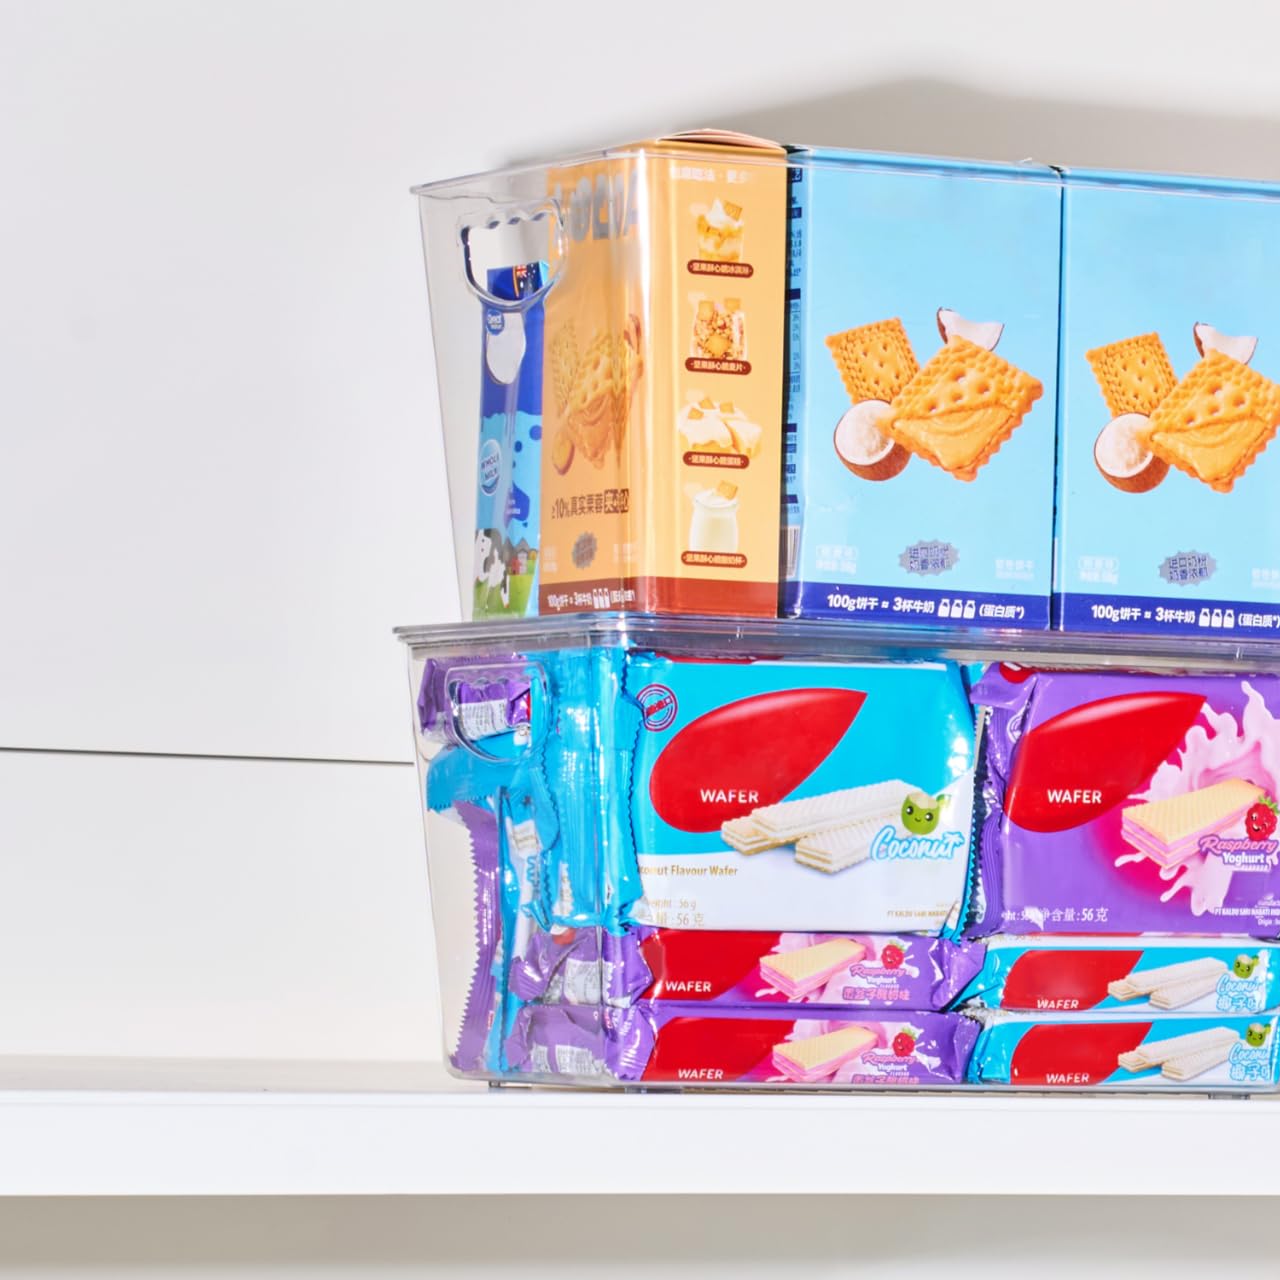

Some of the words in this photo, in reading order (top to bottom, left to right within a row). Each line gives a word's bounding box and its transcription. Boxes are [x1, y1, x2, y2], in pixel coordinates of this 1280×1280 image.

[700, 788, 759, 803] WAFER
[1047, 790, 1102, 804] WAFER
[871, 825, 965, 862] Coconut
[1199, 836, 1278, 853] Raspberry
[1222, 851, 1265, 866] Yoghurt
[671, 865, 707, 876] Flavour
[709, 866, 738, 875] Wafer
[665, 981, 711, 993] WAFER
[867, 976, 897, 986] Yoghurt
[1037, 999, 1079, 1009] WAFER
[678, 1069, 724, 1080] WAFER
[1045, 1073, 1090, 1083] WAFER
